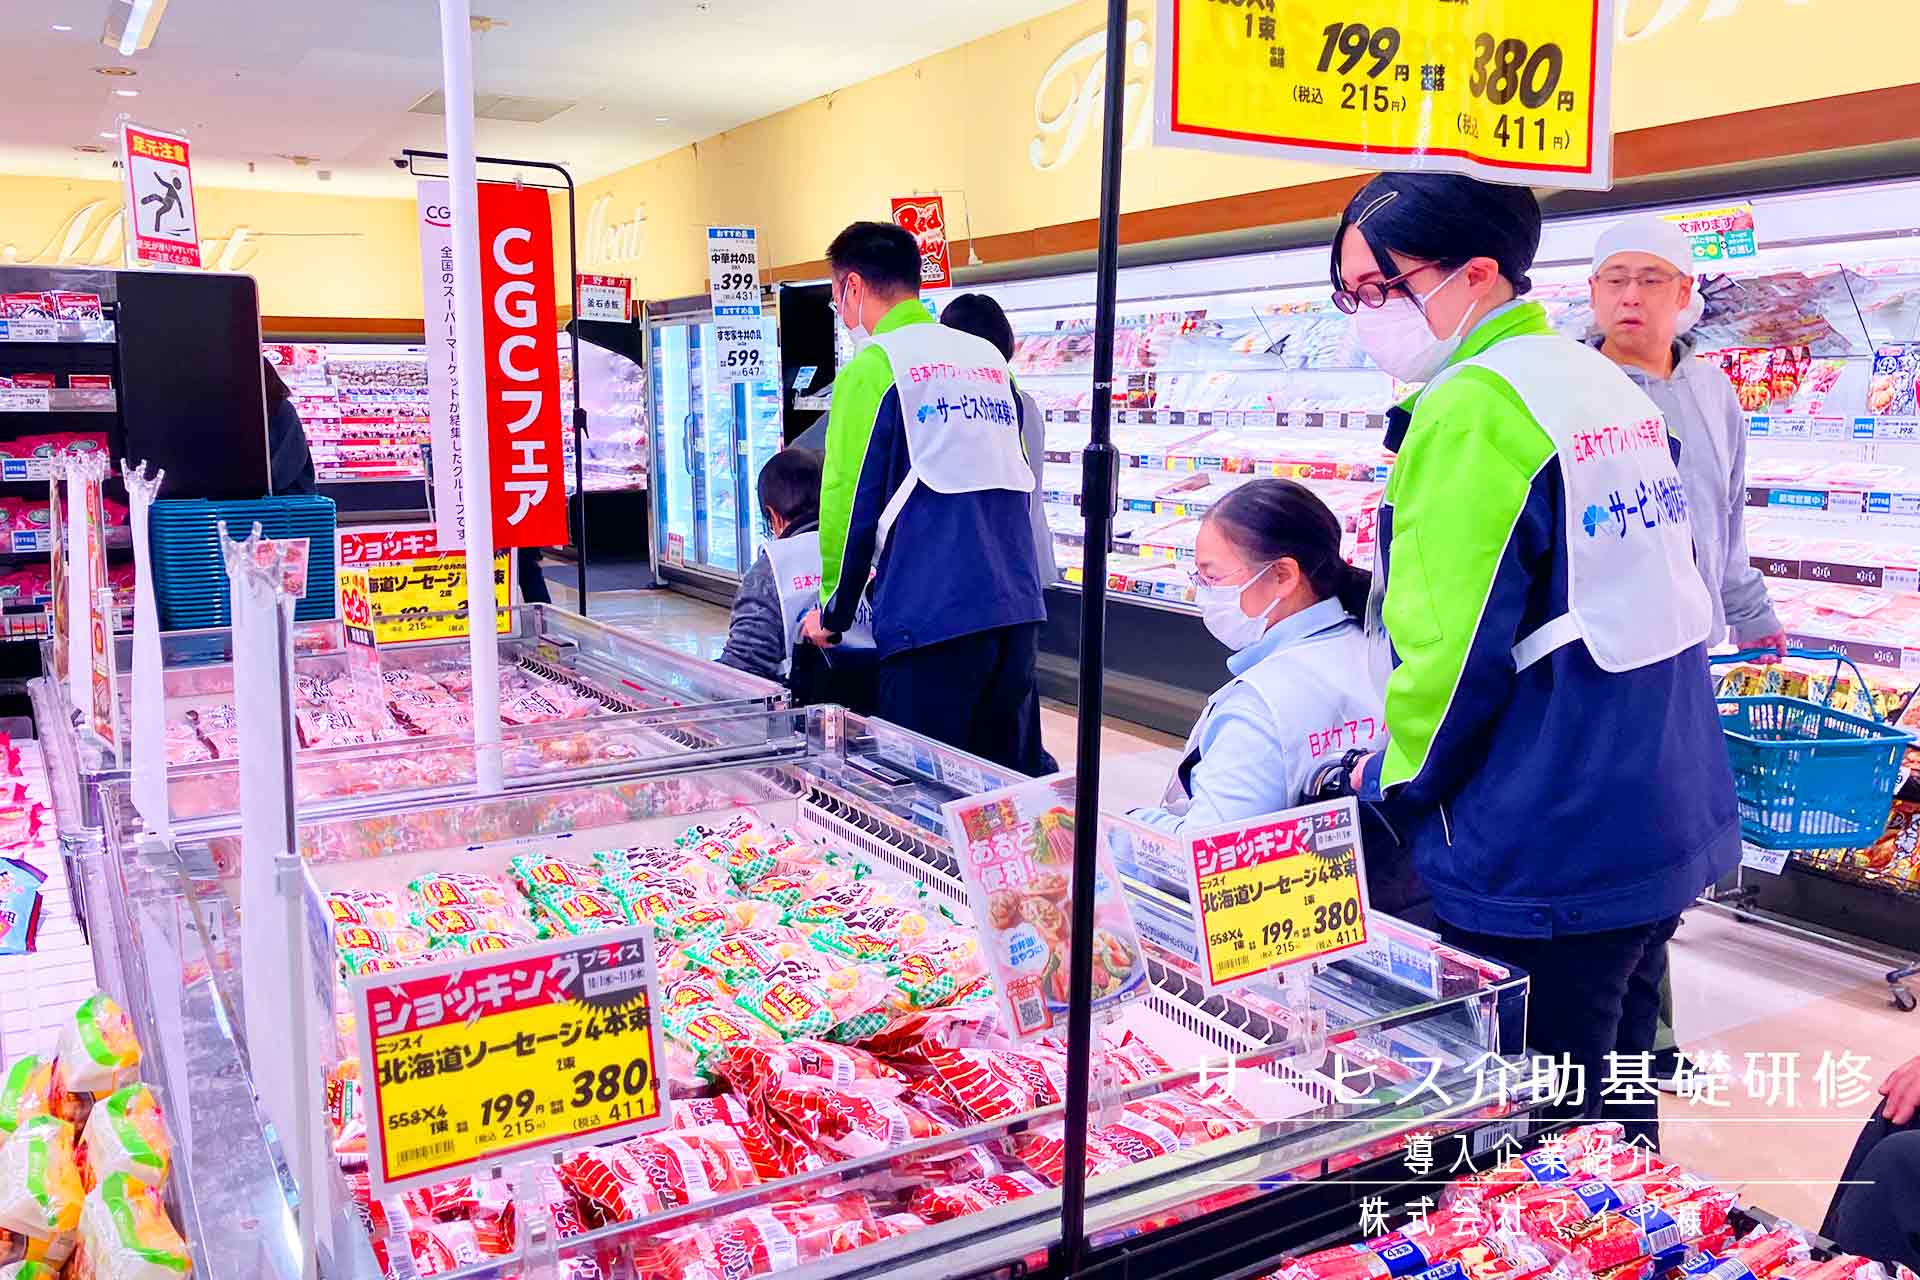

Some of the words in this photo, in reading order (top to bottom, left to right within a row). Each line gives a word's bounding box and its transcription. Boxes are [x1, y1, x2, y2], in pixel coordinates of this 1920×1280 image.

[426, 205, 451, 220] CG
[711, 252, 756, 265] 中華丼の具
[492, 226, 550, 527] CGCフェア
[1196, 817, 1314, 875] ショッキング
[1314, 811, 1350, 829] プライス
[1199, 875, 1227, 890] ニッスイ
[1201, 858, 1357, 915] 北海道ソーセージ4本束
[374, 951, 581, 1036] ショッキング
[582, 943, 641, 969] プライス
[376, 1034, 424, 1055] ニッスイ
[377, 1008, 651, 1088] 北海道ソーセージ4本束
